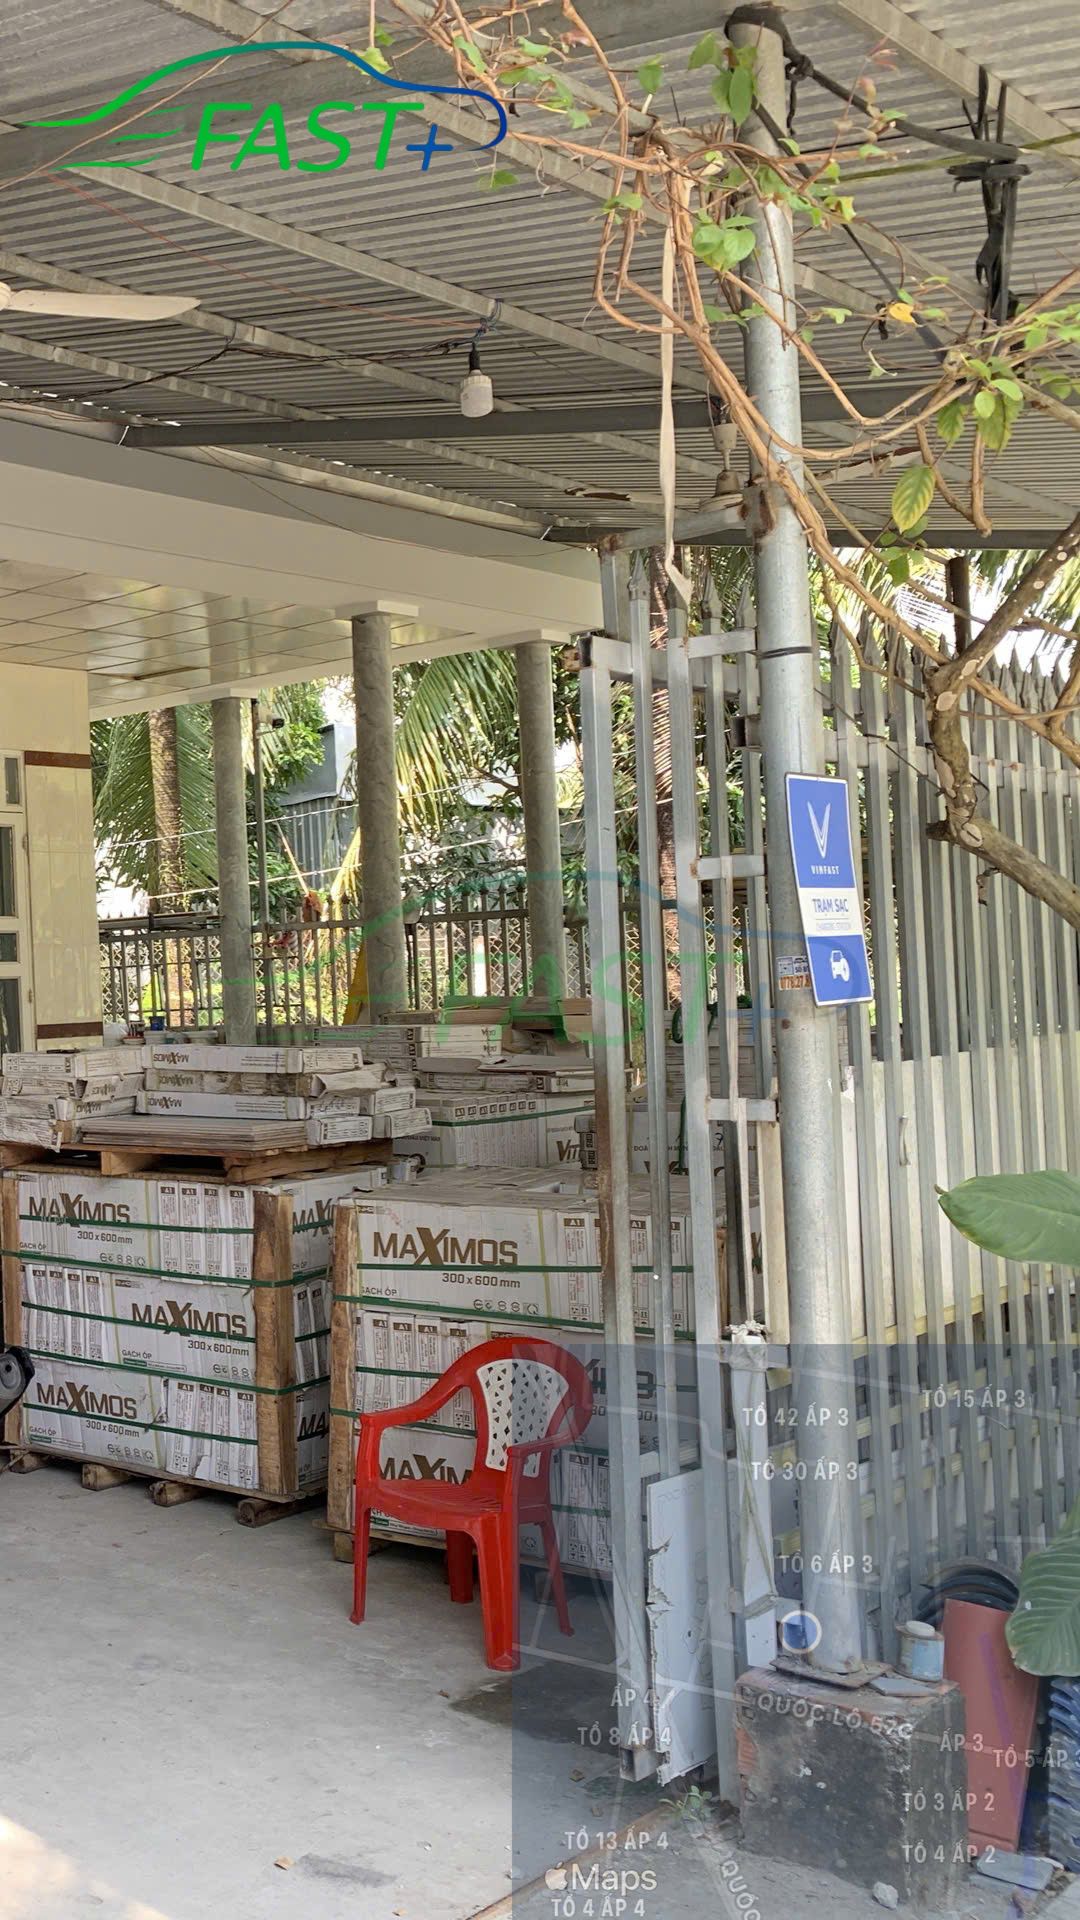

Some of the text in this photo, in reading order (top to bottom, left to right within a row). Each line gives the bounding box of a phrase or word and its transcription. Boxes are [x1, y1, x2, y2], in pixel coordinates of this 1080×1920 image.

[810, 865, 840, 875] VINFAST
[153, 1051, 189, 1065] MAXIMOS
[29, 1193, 131, 1227] MAXIMOS
[373, 1227, 518, 1267] MAXIMOS
[131, 1300, 247, 1337] MAXIMOS
[36, 1381, 137, 1419] MAXIMOS
